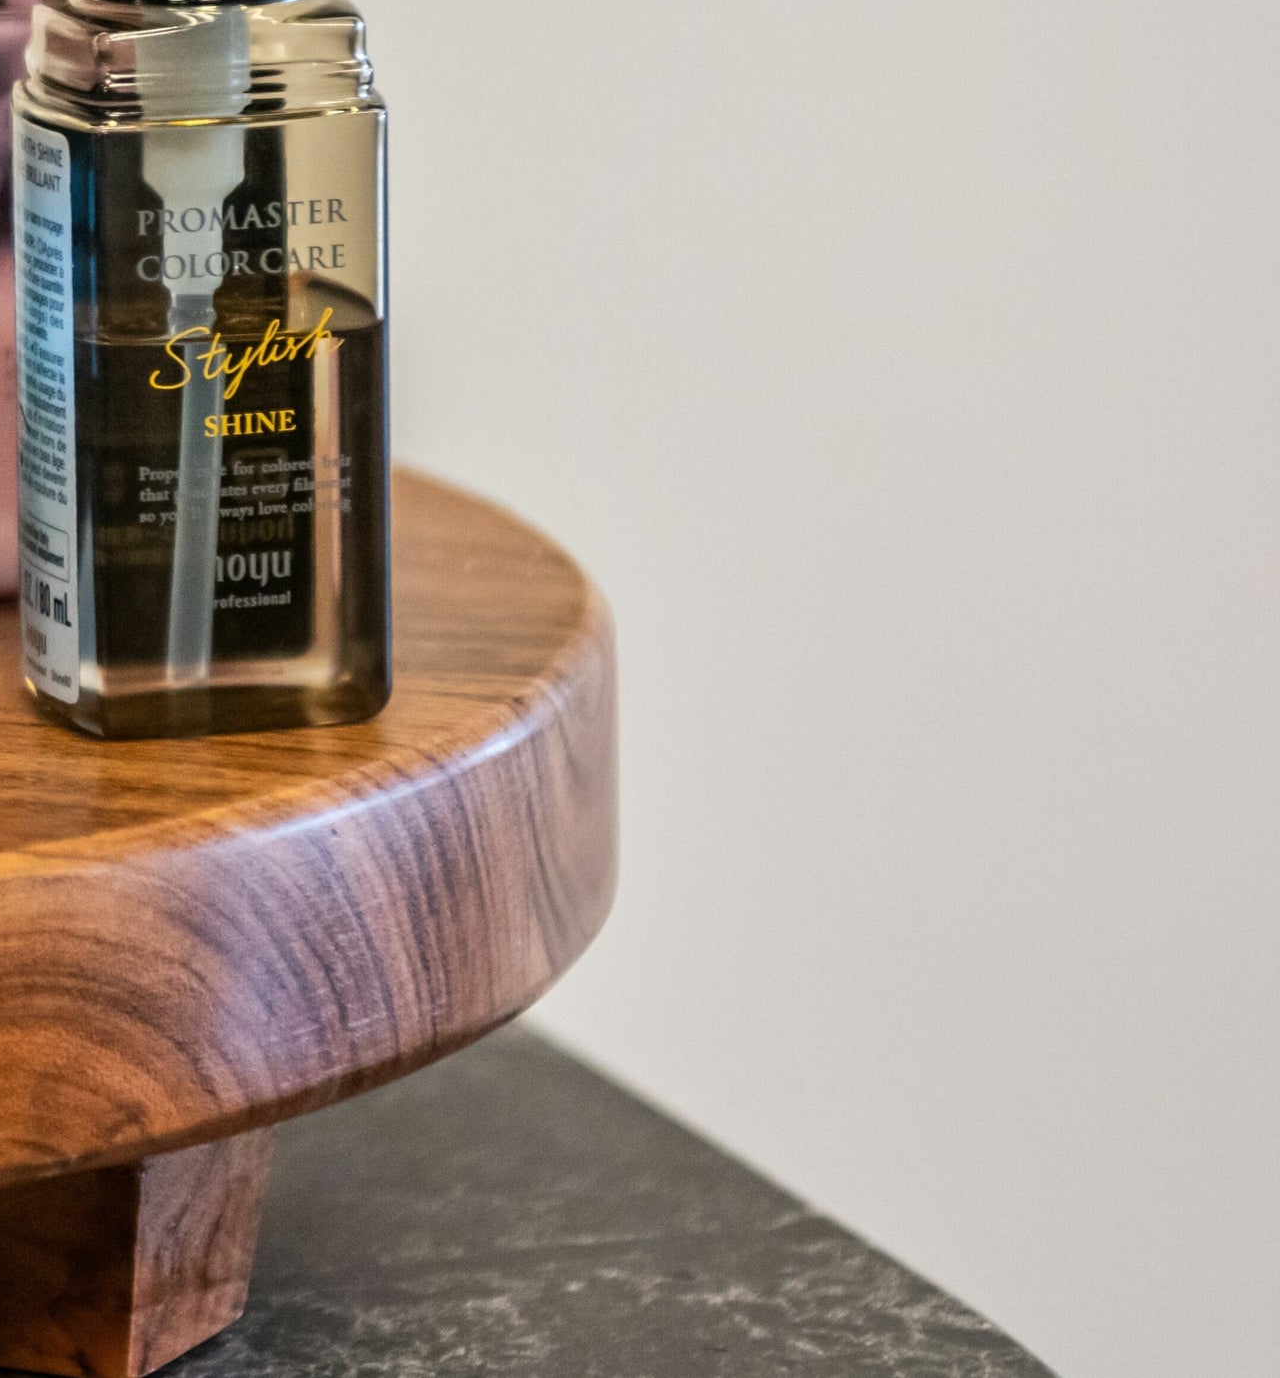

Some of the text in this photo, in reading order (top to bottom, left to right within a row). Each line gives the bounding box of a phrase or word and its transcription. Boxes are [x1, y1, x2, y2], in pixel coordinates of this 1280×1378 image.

[137, 198, 349, 236] PROMASTER
[136, 244, 347, 282] COLOR CARE
[149, 307, 345, 400] Stylish
[203, 409, 297, 438] SHINE
[233, 460, 255, 476] for
[139, 486, 170, 503] that
[252, 481, 291, 498] every
[258, 500, 289, 517] love
[214, 590, 292, 609] rofessional
